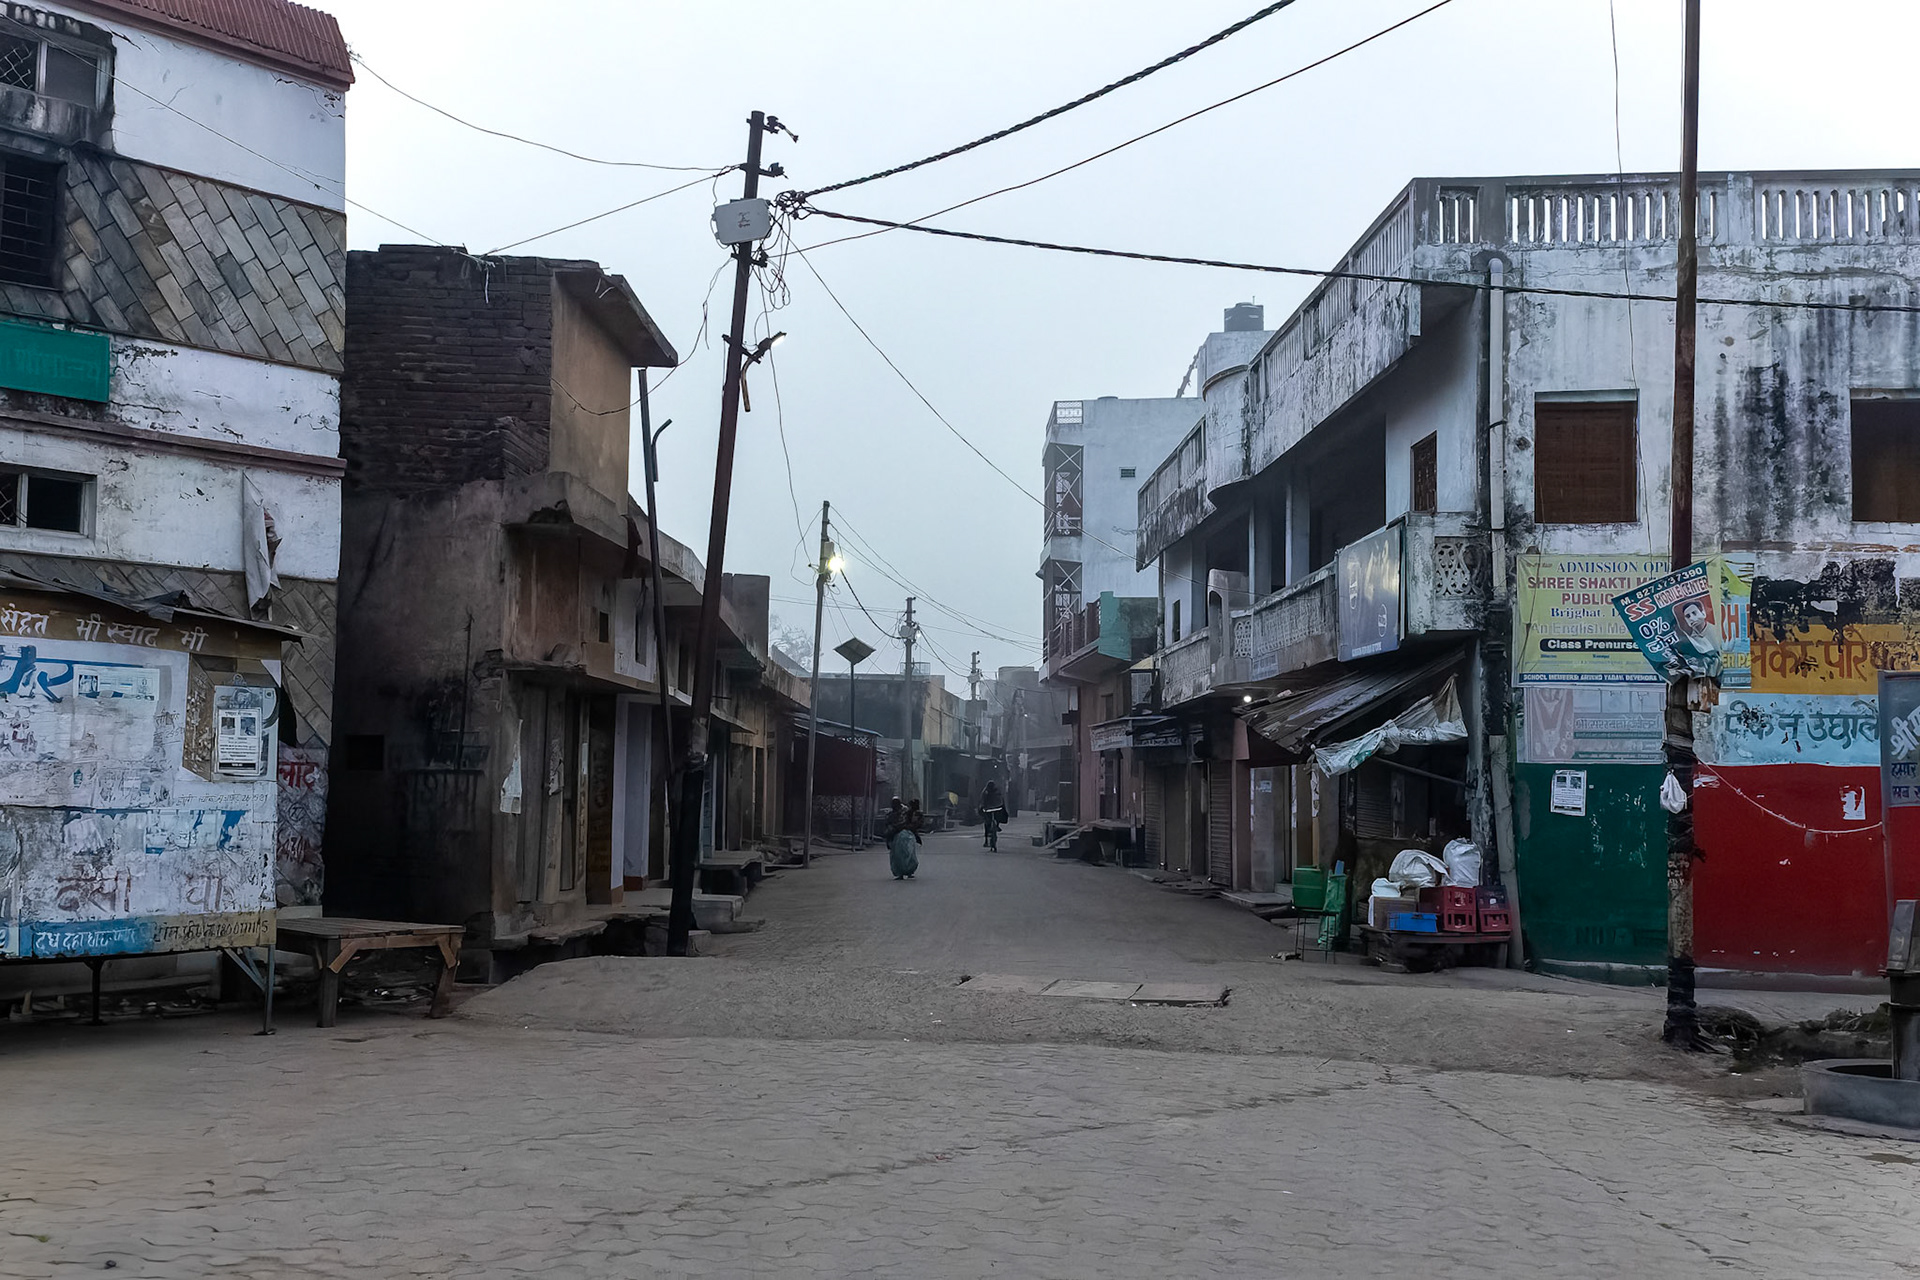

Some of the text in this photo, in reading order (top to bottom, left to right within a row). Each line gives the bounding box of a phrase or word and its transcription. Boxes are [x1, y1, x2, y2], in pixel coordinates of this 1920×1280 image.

[1557, 561, 1638, 573] ADMISSION
[1527, 577, 1574, 589] SHREE
[1579, 577, 1631, 589] SHAKTI
[1561, 593, 1613, 605] PUBLIC
[1624, 597, 1657, 622] SS
[1552, 622, 1603, 636] English
[1547, 639, 1582, 649] Class
